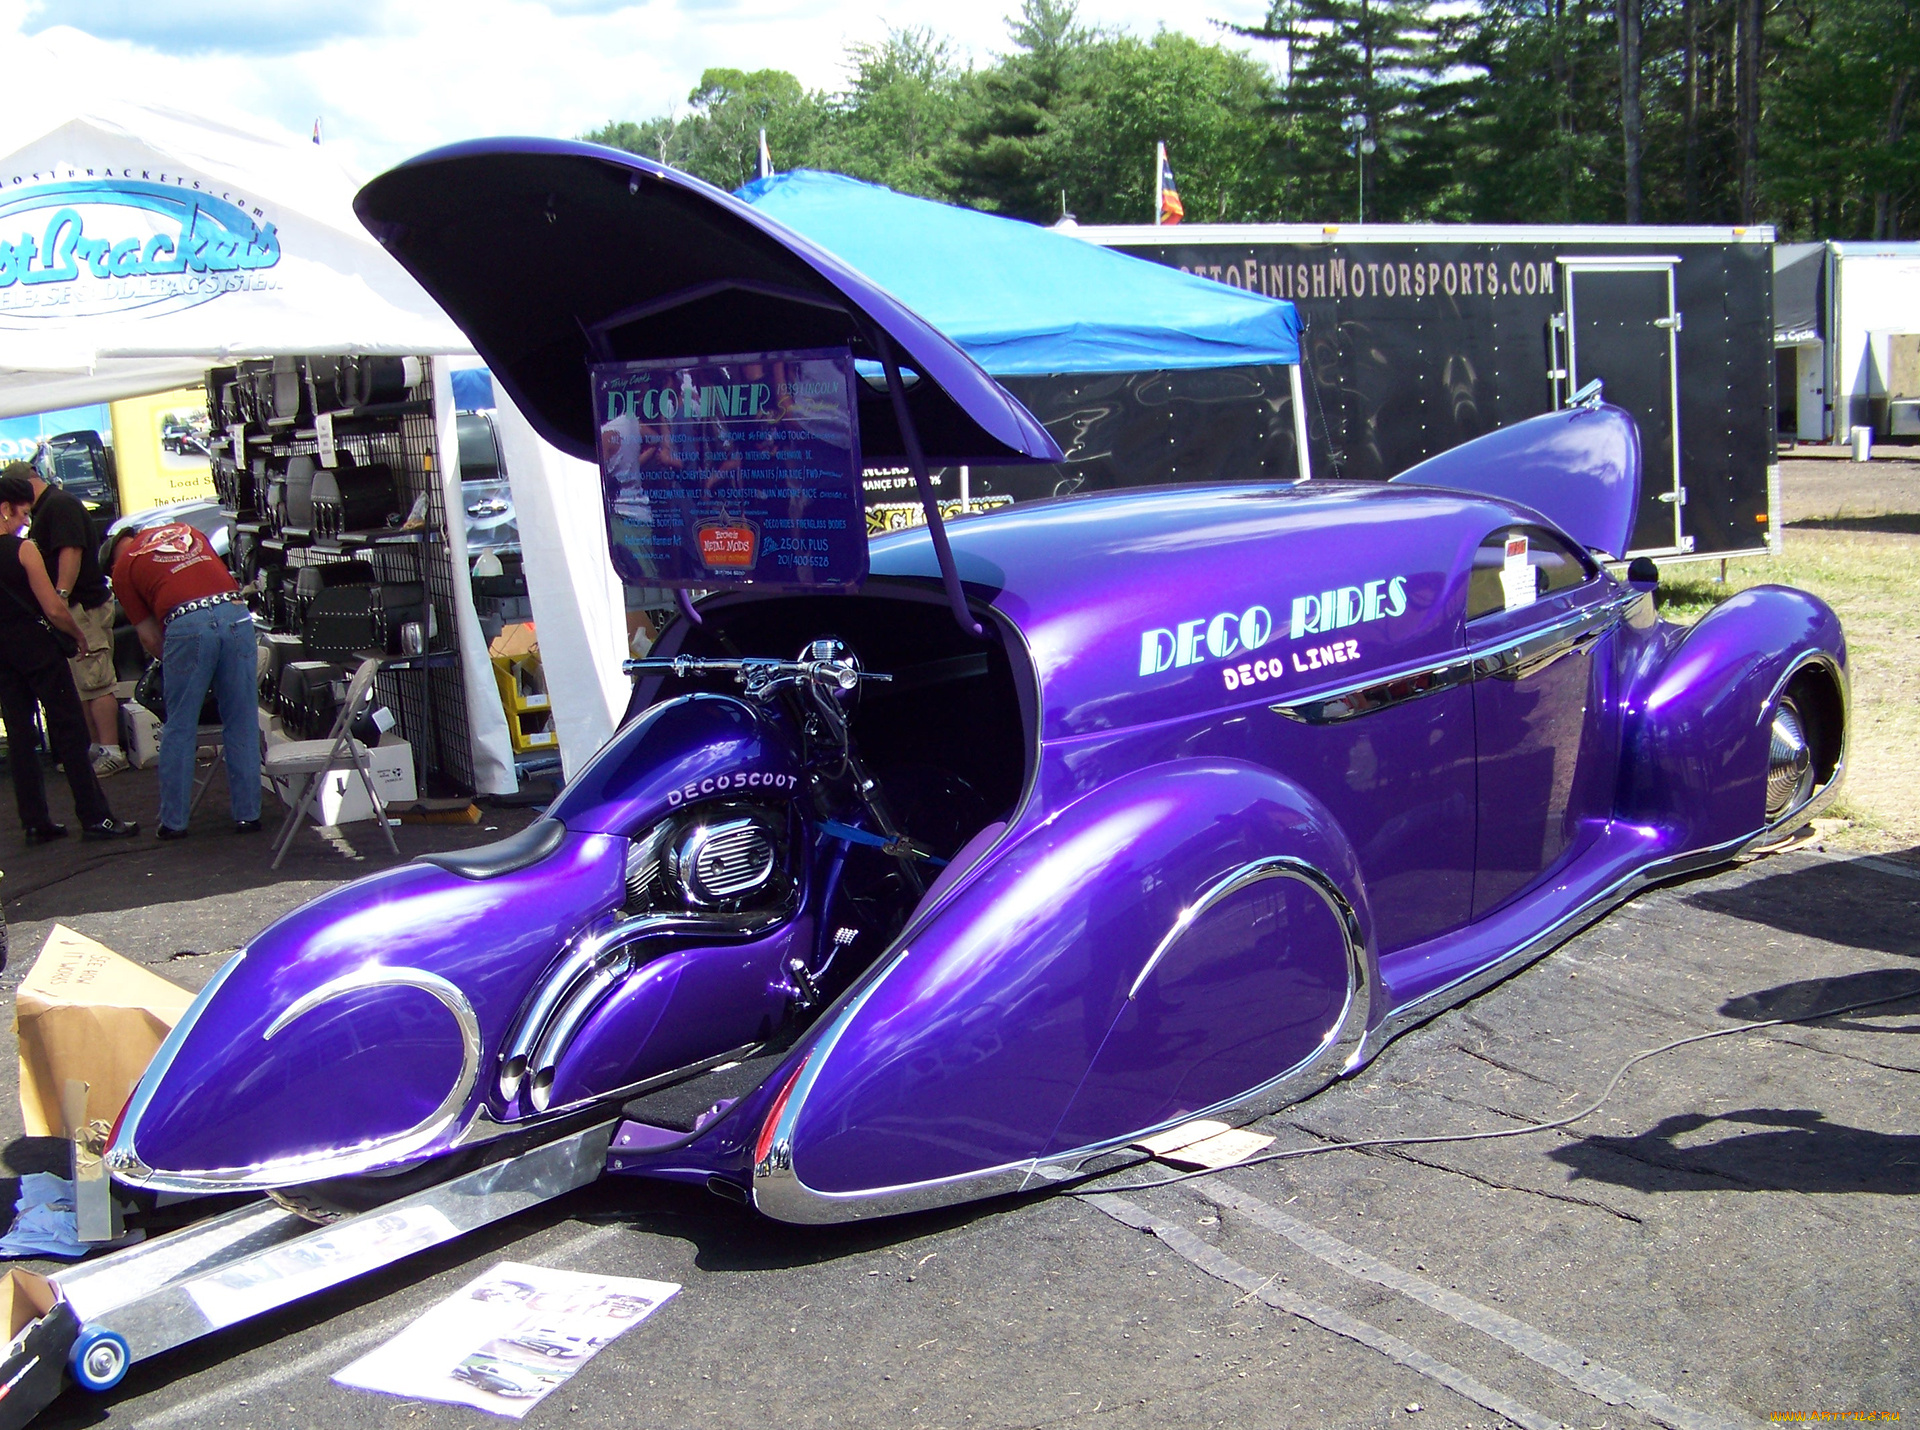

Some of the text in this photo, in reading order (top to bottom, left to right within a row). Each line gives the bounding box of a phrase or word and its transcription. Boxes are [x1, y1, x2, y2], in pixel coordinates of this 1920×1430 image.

[777, 381, 839, 394] 1939 LINCOLN
[607, 389, 679, 421] DECO
[684, 383, 771, 419] LINER
[169, 477, 200, 489] Load
[893, 477, 908, 488] UP
[704, 540, 725, 552] METAL
[726, 540, 750, 552] MODS
[808, 538, 830, 551] PLUS
[1139, 575, 1408, 676] DECO RIDES
[1223, 639, 1362, 691] DECO LINER
[87, 954, 111, 967] SEE
